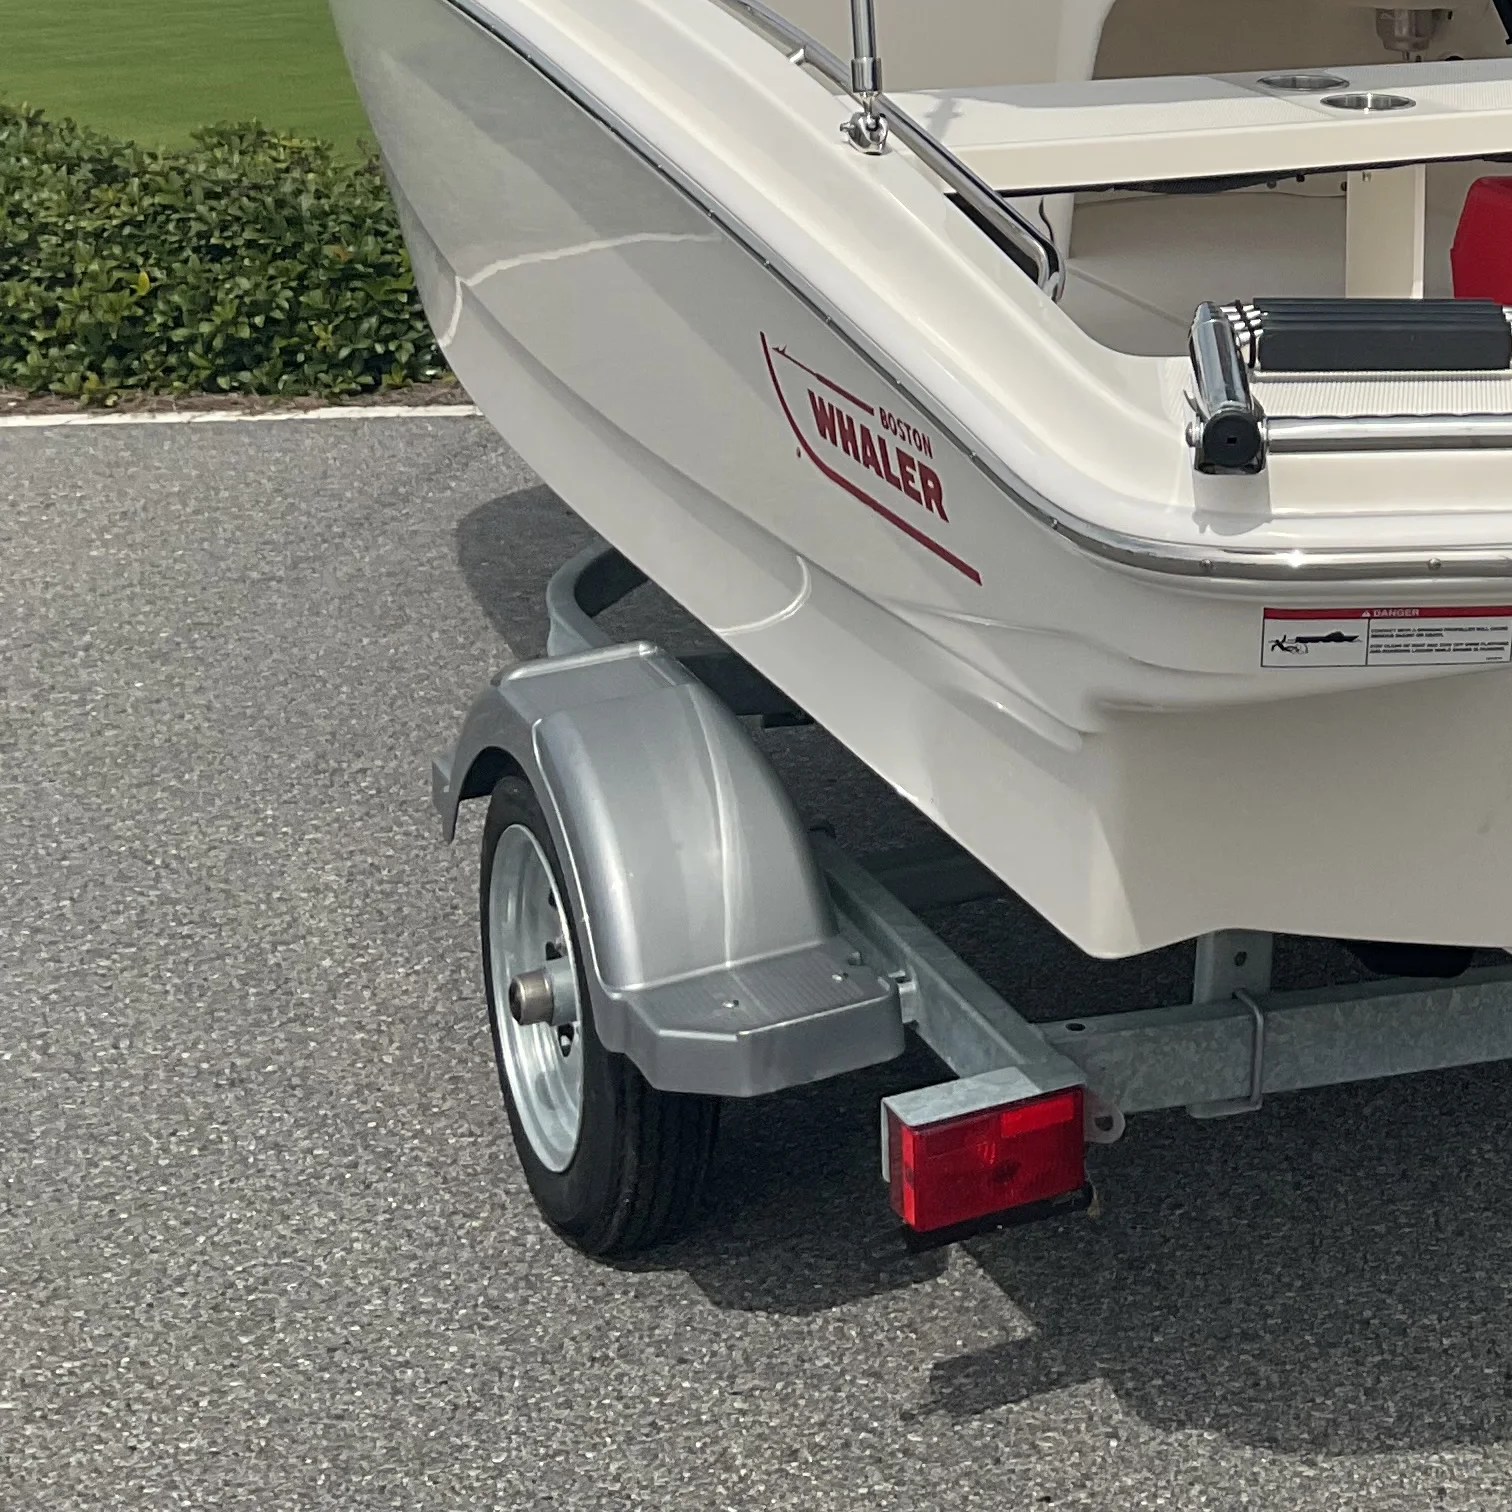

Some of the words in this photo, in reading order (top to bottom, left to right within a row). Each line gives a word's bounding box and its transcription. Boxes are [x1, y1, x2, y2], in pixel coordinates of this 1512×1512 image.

[808, 388, 949, 523] WHALER
[879, 406, 933, 459] BOSTON
[1373, 608, 1420, 617] DANGER
